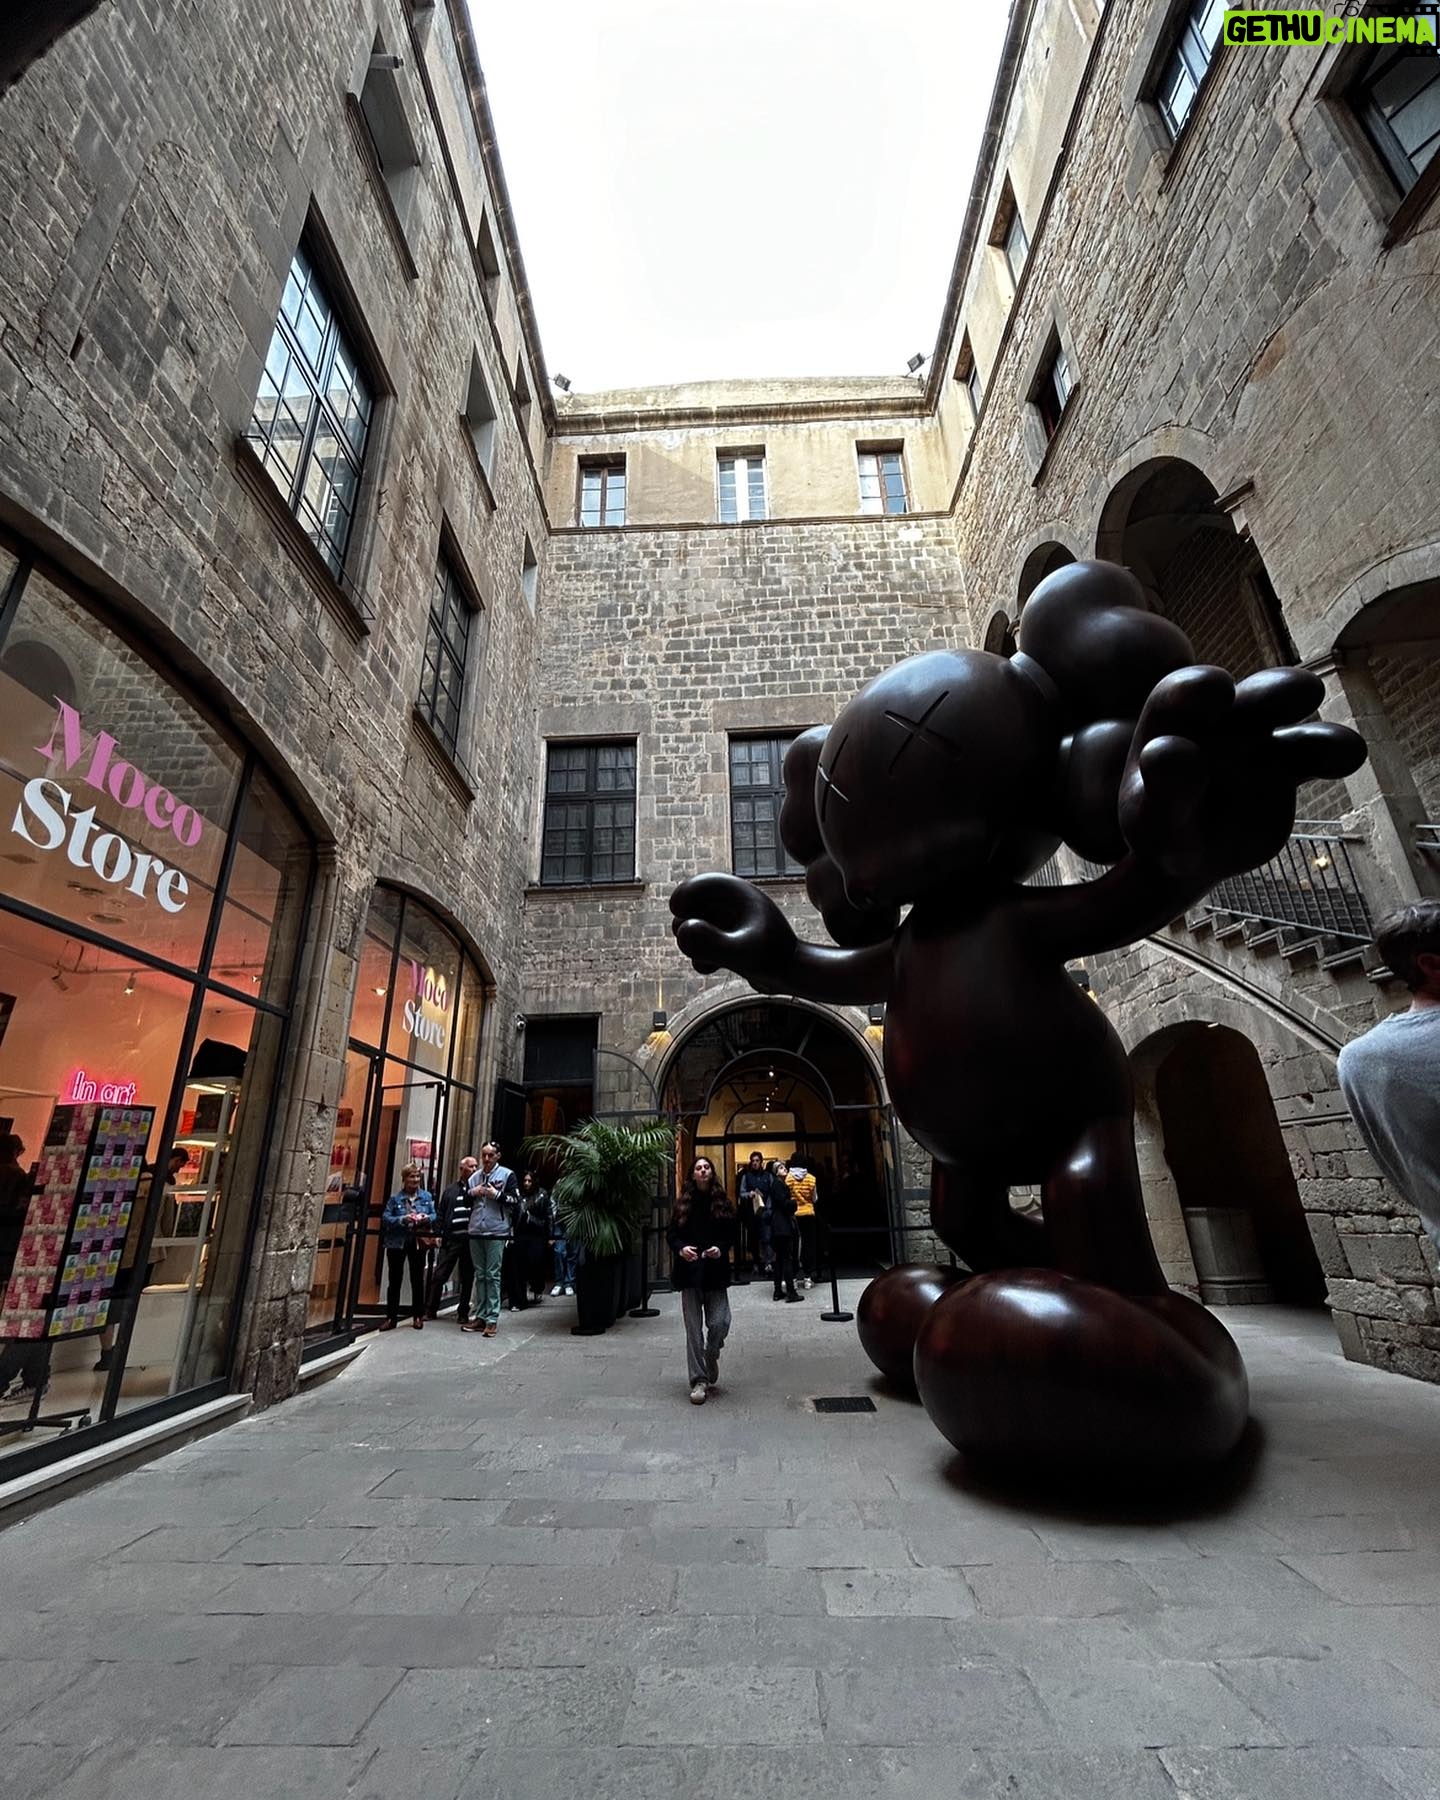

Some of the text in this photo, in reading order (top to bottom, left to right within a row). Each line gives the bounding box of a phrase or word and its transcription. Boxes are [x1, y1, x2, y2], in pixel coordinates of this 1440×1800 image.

[34, 694, 202, 847] Moco
[11, 777, 189, 913] Store
[402, 999, 445, 1049] Store
[72, 1071, 136, 1106] In art
